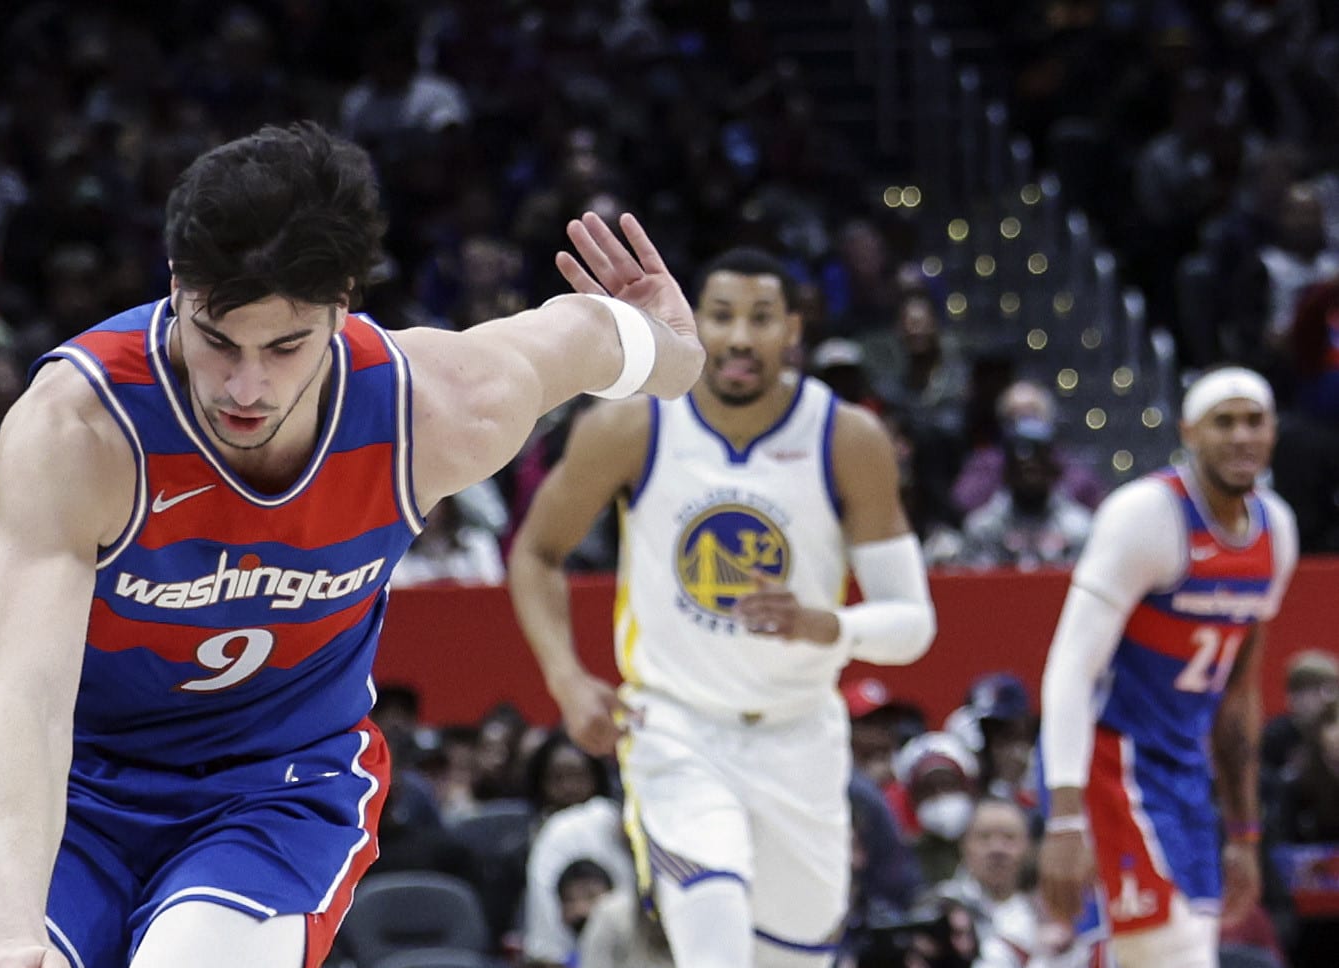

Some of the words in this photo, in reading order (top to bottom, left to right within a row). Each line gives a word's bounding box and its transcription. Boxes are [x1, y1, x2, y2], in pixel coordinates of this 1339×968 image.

[115, 549, 386, 609] washington
[737, 530, 780, 568] 32
[173, 627, 276, 693] 9
